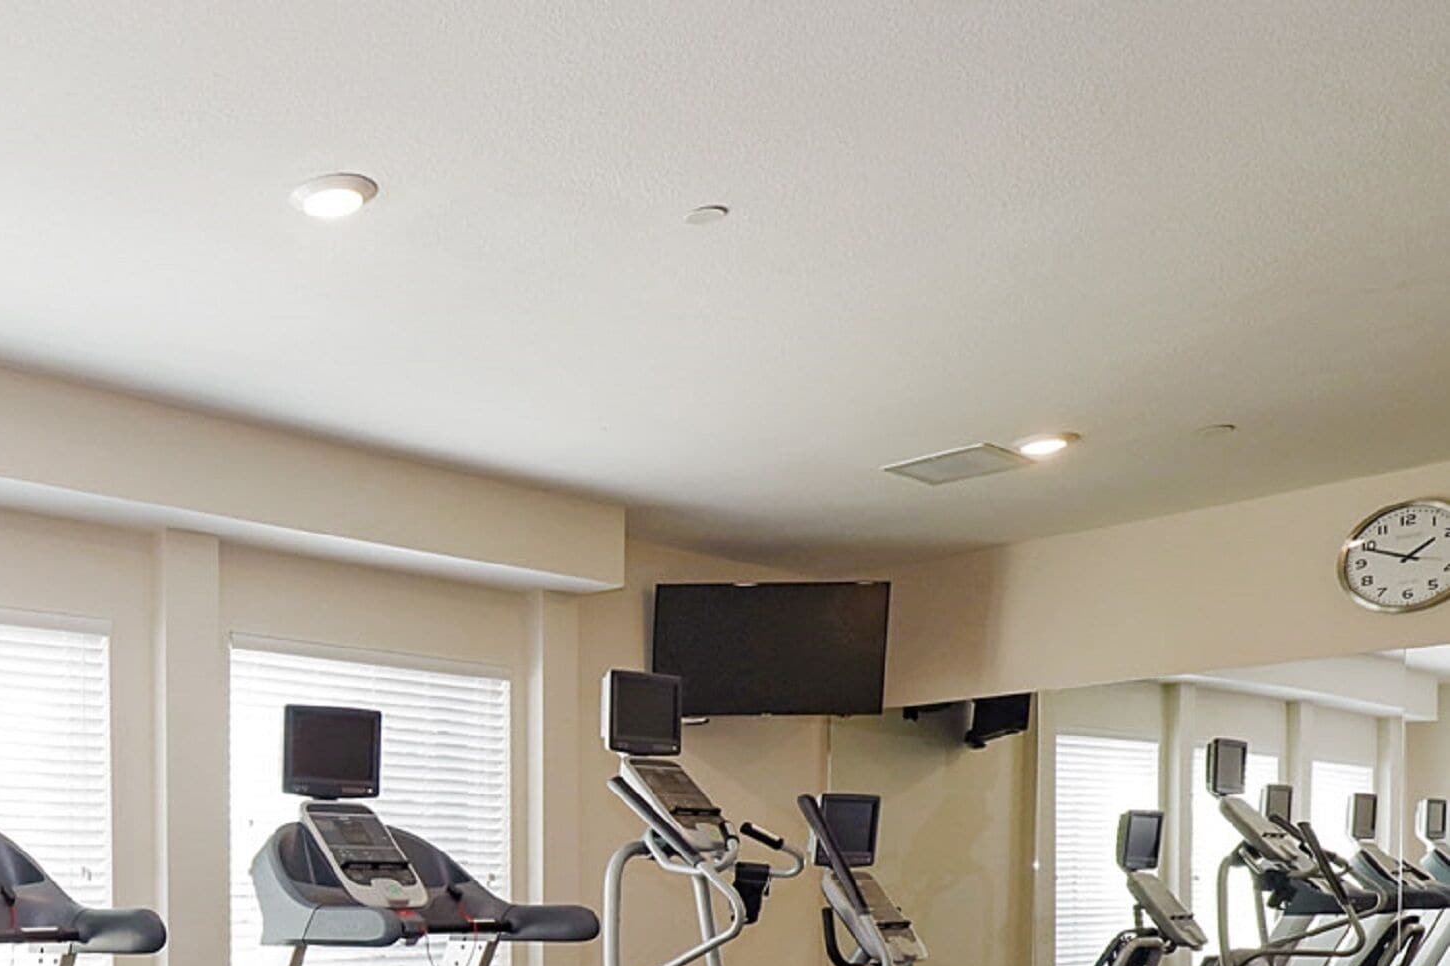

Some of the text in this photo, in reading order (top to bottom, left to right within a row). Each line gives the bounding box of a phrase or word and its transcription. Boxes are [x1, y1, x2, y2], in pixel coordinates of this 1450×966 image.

[1400, 514, 1417, 526] 12
[1432, 516, 1437, 526] 1
[1377, 525, 1389, 535] 11
[1355, 559, 1367, 570] 9
[1361, 576, 1373, 586] 8
[1428, 579, 1438, 590] 5
[1377, 588, 1387, 597] 7
[1402, 589, 1413, 599] 6
